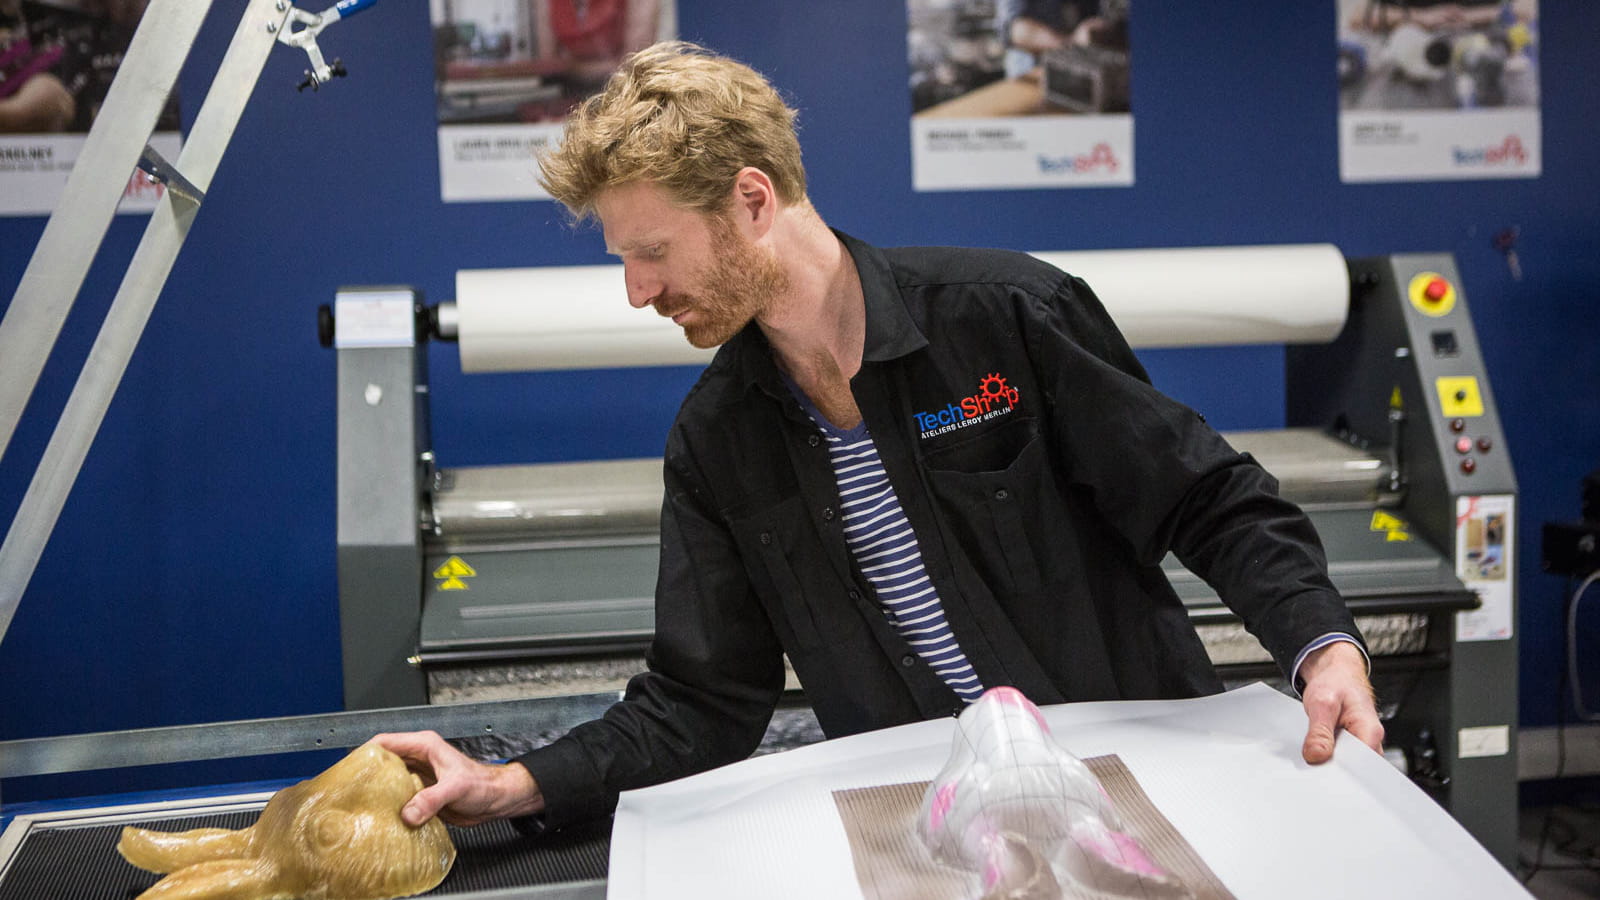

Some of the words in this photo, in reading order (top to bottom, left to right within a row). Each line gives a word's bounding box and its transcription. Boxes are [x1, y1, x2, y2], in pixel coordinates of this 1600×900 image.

[914, 372, 1019, 432] TechShop
[921, 423, 957, 440] ATELIERS
[957, 415, 982, 429] LEROY
[983, 406, 1012, 420] MERLIN
